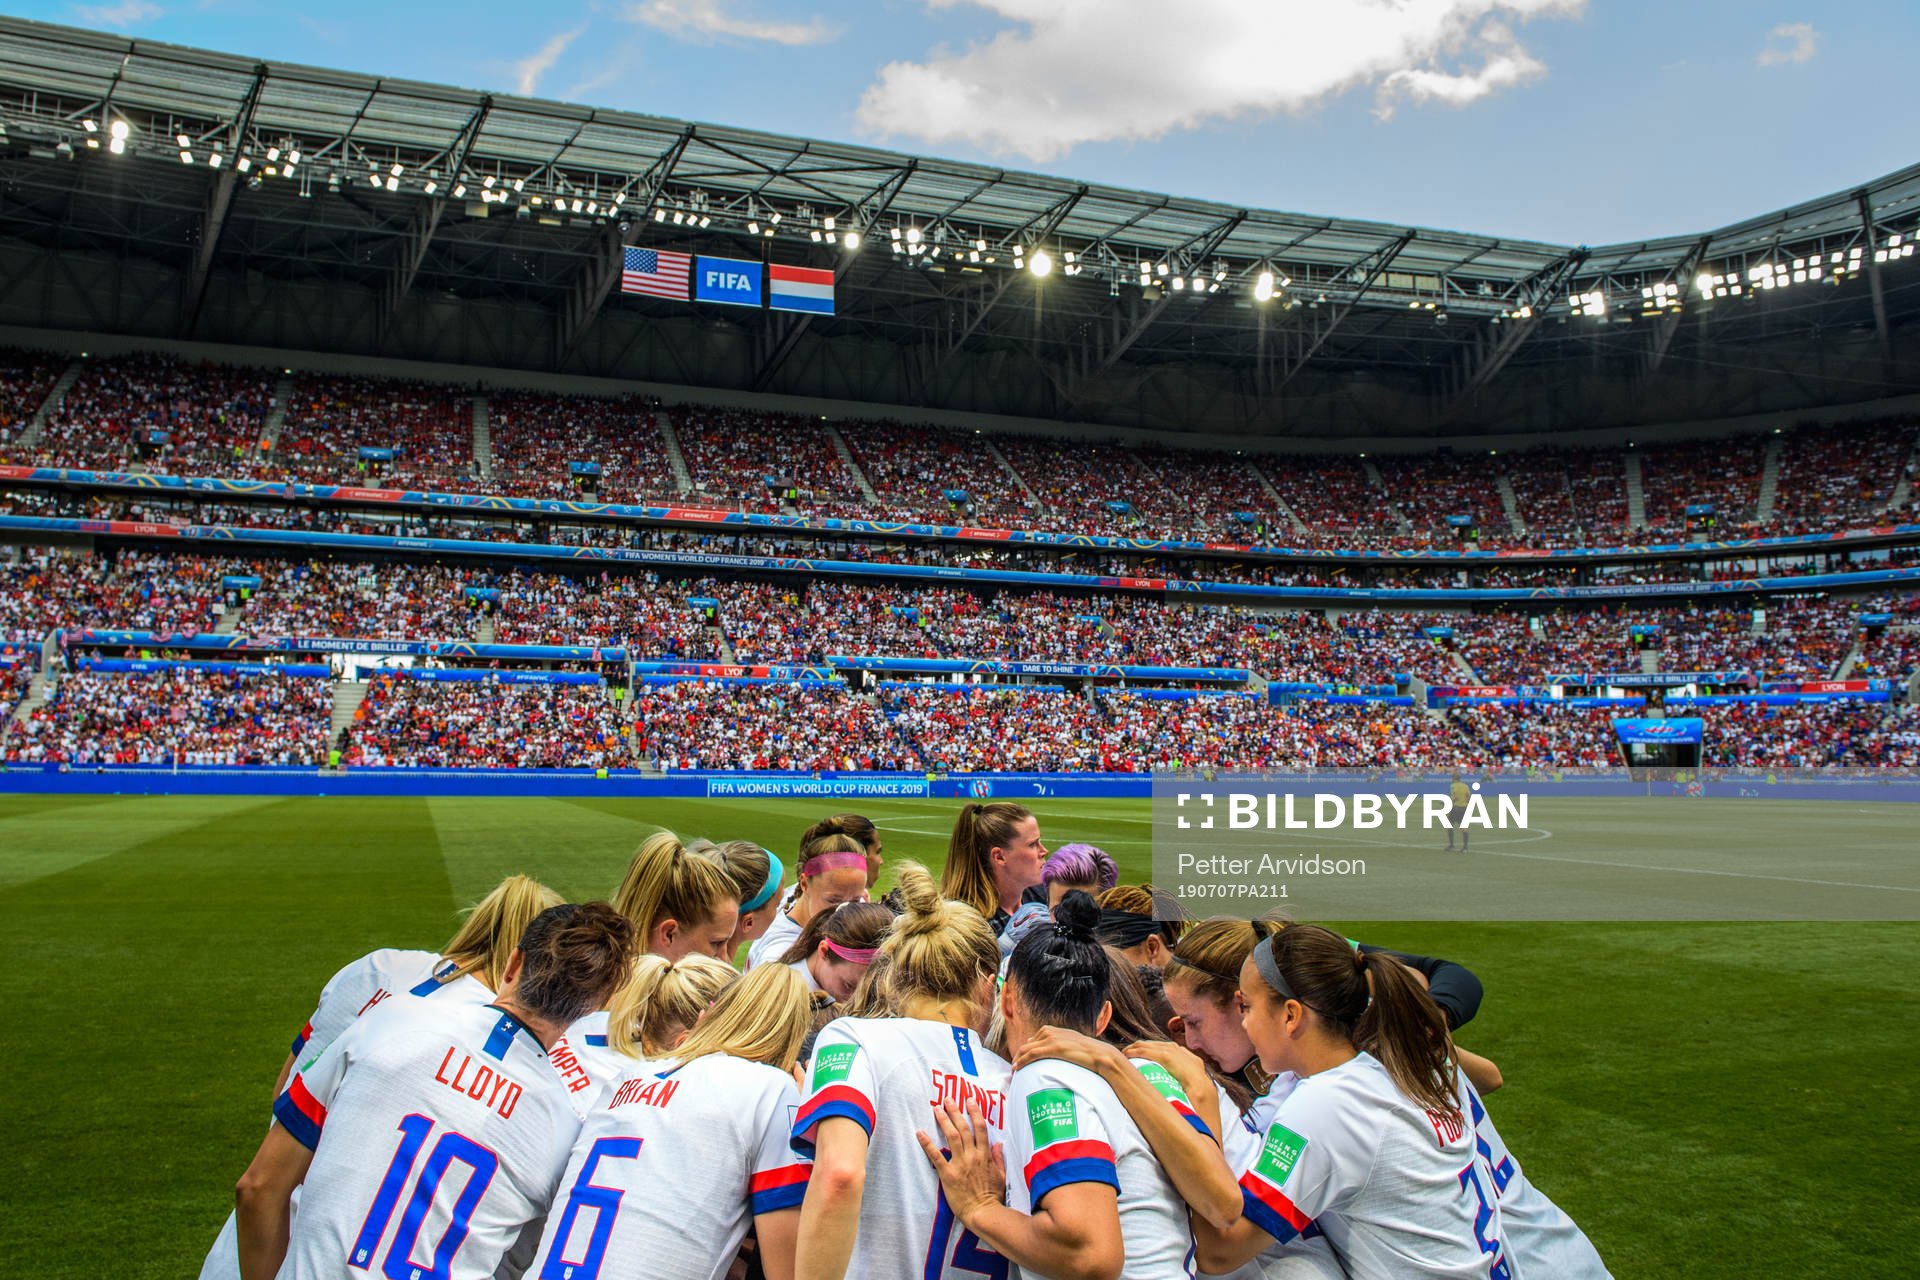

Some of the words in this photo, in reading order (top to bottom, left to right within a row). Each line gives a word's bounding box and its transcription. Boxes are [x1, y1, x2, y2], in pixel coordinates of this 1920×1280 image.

[706, 271, 751, 291] FIFA
[134, 526, 158, 534] LYON
[642, 553, 677, 561] WOMEN'S
[678, 554, 705, 563] WORLD
[705, 555, 720, 563] CUP
[721, 557, 748, 565] FRANCE
[749, 558, 764, 566] 2019
[298, 640, 311, 649] LE
[311, 641, 355, 650] MOMENT
[356, 642, 369, 650] DE
[371, 642, 408, 652] BRILLER
[1042, 665, 1052, 673] TO
[1053, 666, 1074, 674] SHINE
[1606, 675, 1617, 683] LE
[1653, 675, 1664, 683] DE
[1821, 682, 1846, 691] LYON
[711, 783, 735, 793] FIFA
[737, 783, 790, 793] WOMEN'S
[792, 784, 832, 794] WORLD
[834, 784, 857, 794] CUP
[859, 784, 898, 794] FRANCE
[900, 784, 923, 794] 2019
[434, 1046, 523, 1120] LLOYD
[608, 1078, 680, 1110] BRIAN
[1031, 1101, 1072, 1115] LIVING
[1031, 1107, 1072, 1121] FOOTBALL
[1053, 1118, 1073, 1127] FIFA
[1271, 1158, 1290, 1172] FIFA
[347, 1113, 499, 1280] 10
[539, 1137, 645, 1280] 6
